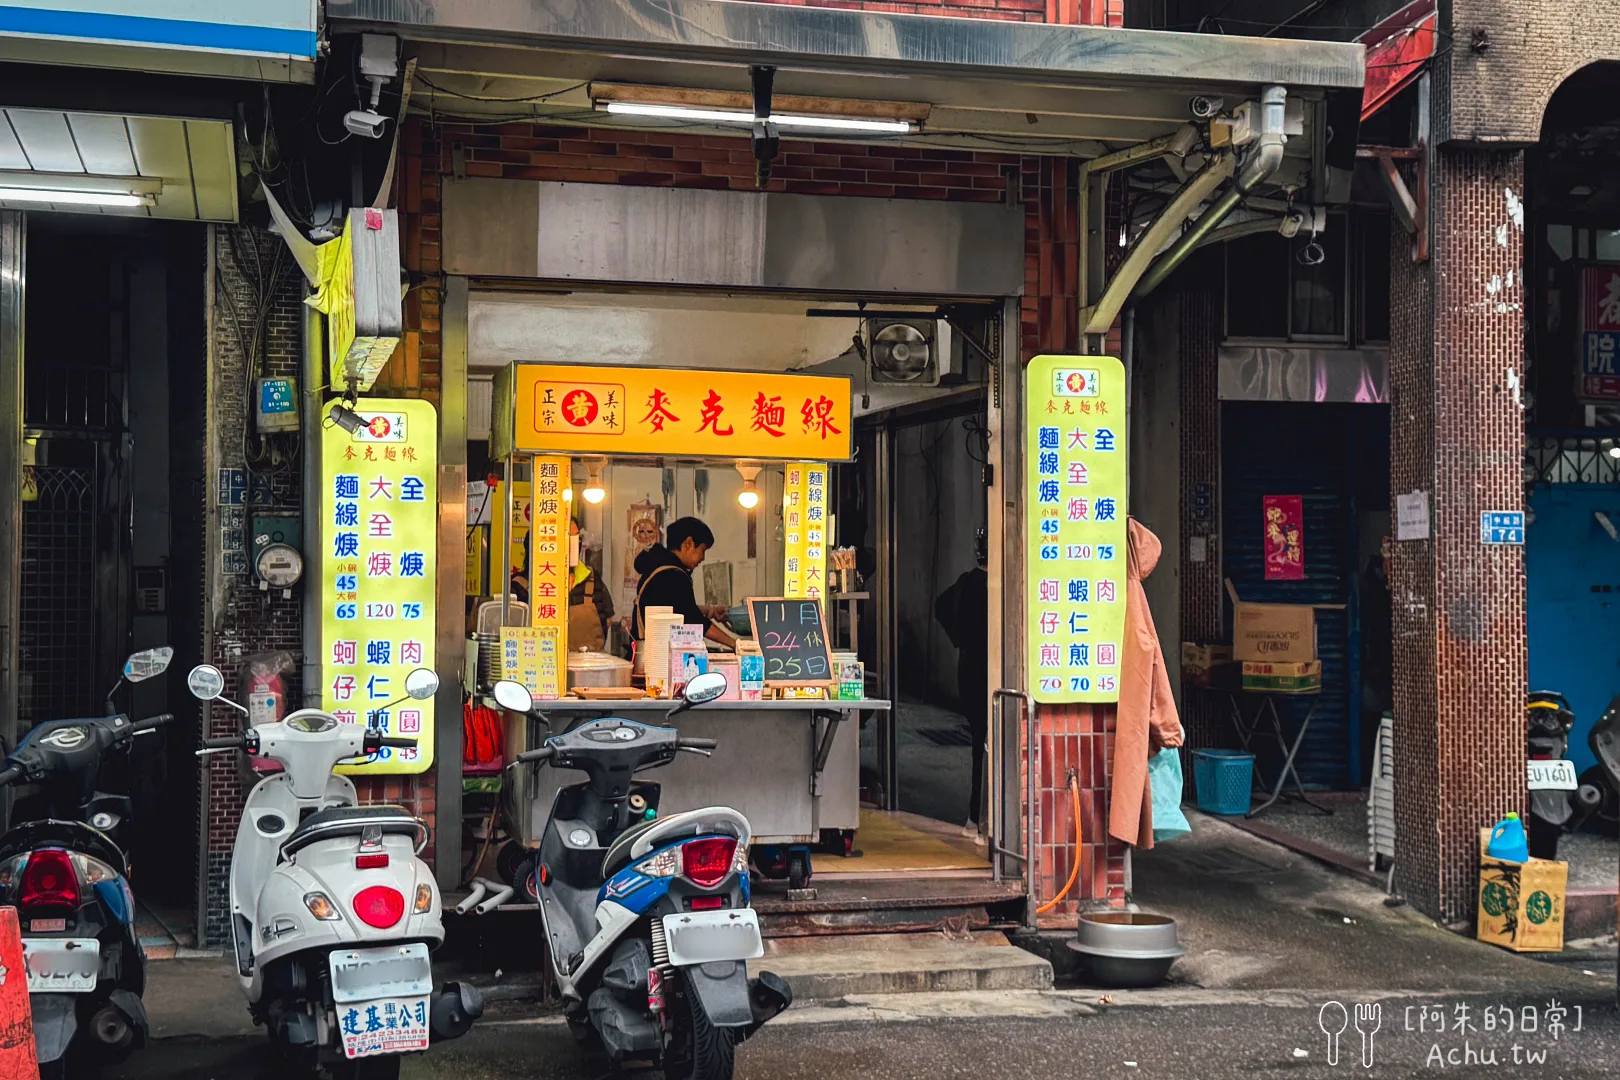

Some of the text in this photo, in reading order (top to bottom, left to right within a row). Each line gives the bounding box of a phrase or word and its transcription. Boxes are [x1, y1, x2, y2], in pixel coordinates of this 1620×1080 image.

[1068, 373, 1084, 393] 黃
[541, 389, 557, 426] 正宗
[569, 391, 594, 424] 黃
[602, 390, 619, 429] 美味
[638, 387, 842, 440] 麥克麵線
[1045, 399, 1109, 416] 麥克麵線
[371, 416, 389, 437] 黃
[343, 445, 418, 462] 麥克麵線
[1039, 427, 1060, 502] 麵線焿
[1068, 427, 1088, 521] 大全焿
[539, 463, 559, 515] 麵線焿
[807, 471, 823, 521] 麵線焿
[334, 475, 359, 557] 麵線焿
[368, 475, 392, 576] 大全焿
[539, 525, 556, 535] 45
[1041, 520, 1058, 533] 45
[788, 534, 799, 542] 70
[808, 531, 820, 541] 45
[539, 542, 556, 552] 65
[808, 548, 820, 558] 65
[1041, 546, 1058, 559] 65
[1067, 546, 1090, 558] 120
[1097, 546, 1113, 559] 75
[336, 576, 356, 590] 45
[537, 561, 558, 619] 大全焿
[336, 604, 356, 618] 65
[366, 604, 394, 618] 120
[402, 604, 420, 618] 75
[1040, 579, 1060, 666] 蚵仔煎
[1068, 579, 1089, 666] 蝦仁煎
[1039, 678, 1062, 690] 70
[1071, 678, 1090, 691] 70
[1097, 676, 1115, 691] 45
